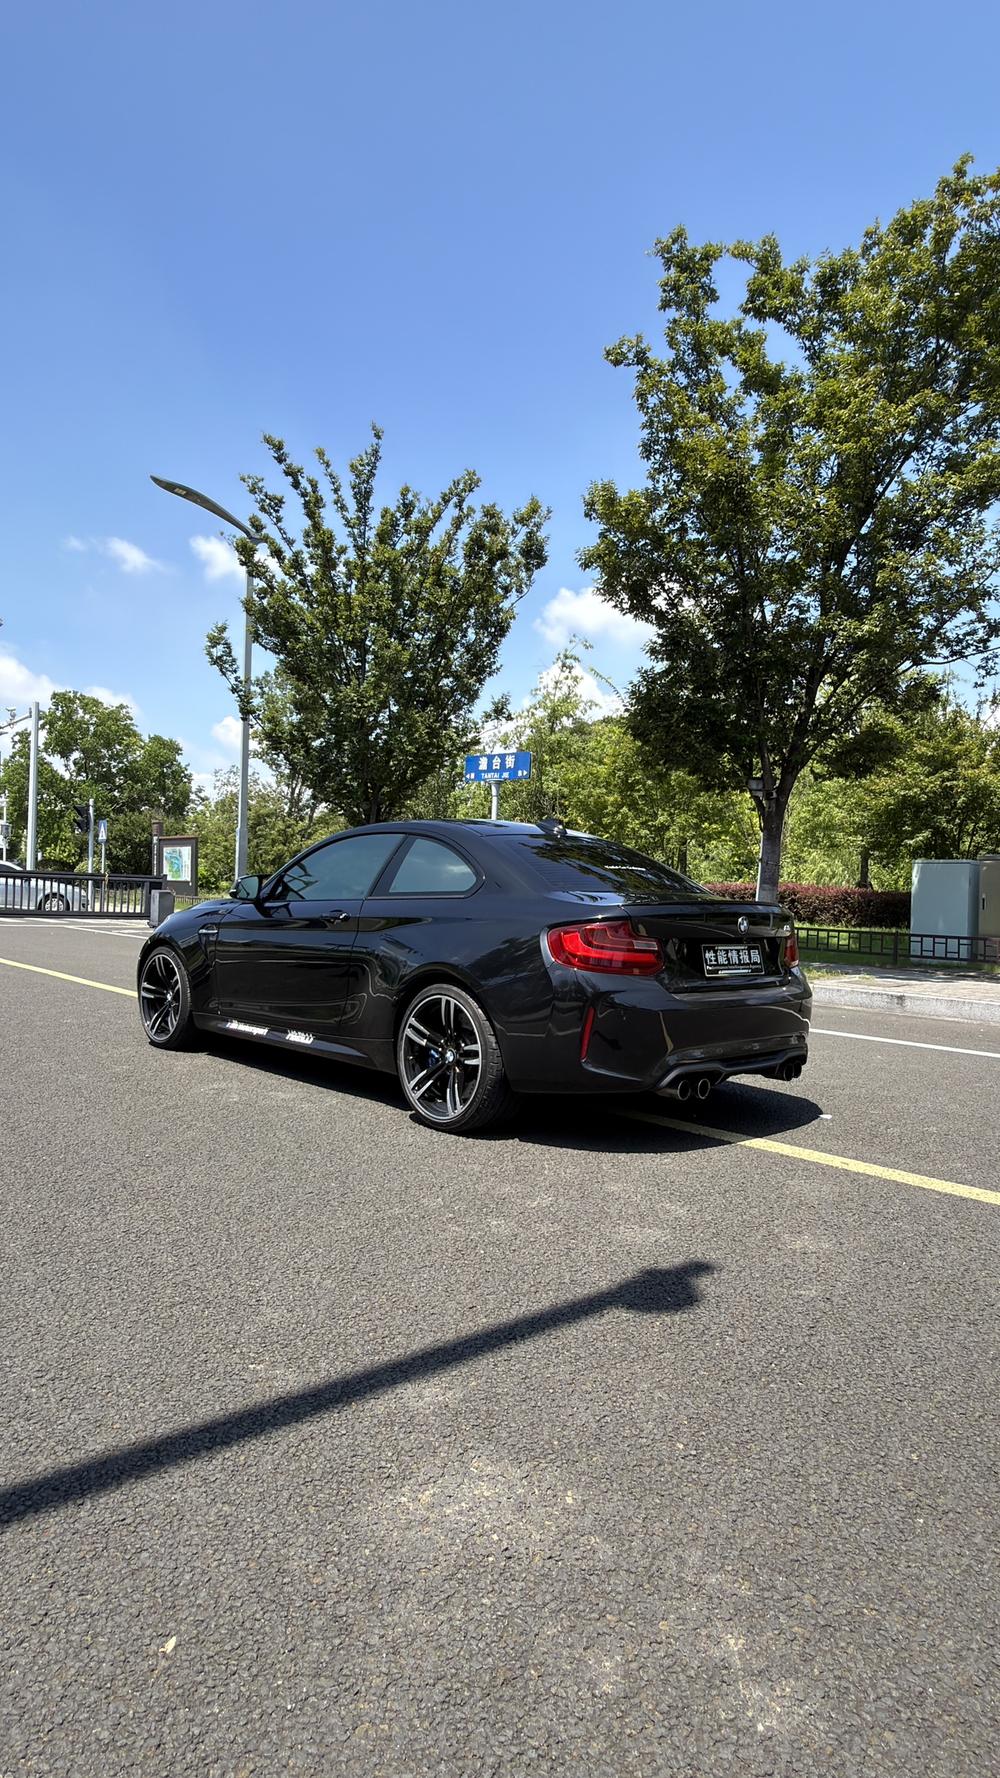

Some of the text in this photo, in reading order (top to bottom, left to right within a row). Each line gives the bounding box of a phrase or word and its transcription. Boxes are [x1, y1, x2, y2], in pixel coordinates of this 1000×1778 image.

[705, 949, 761, 964] 性能情报局
